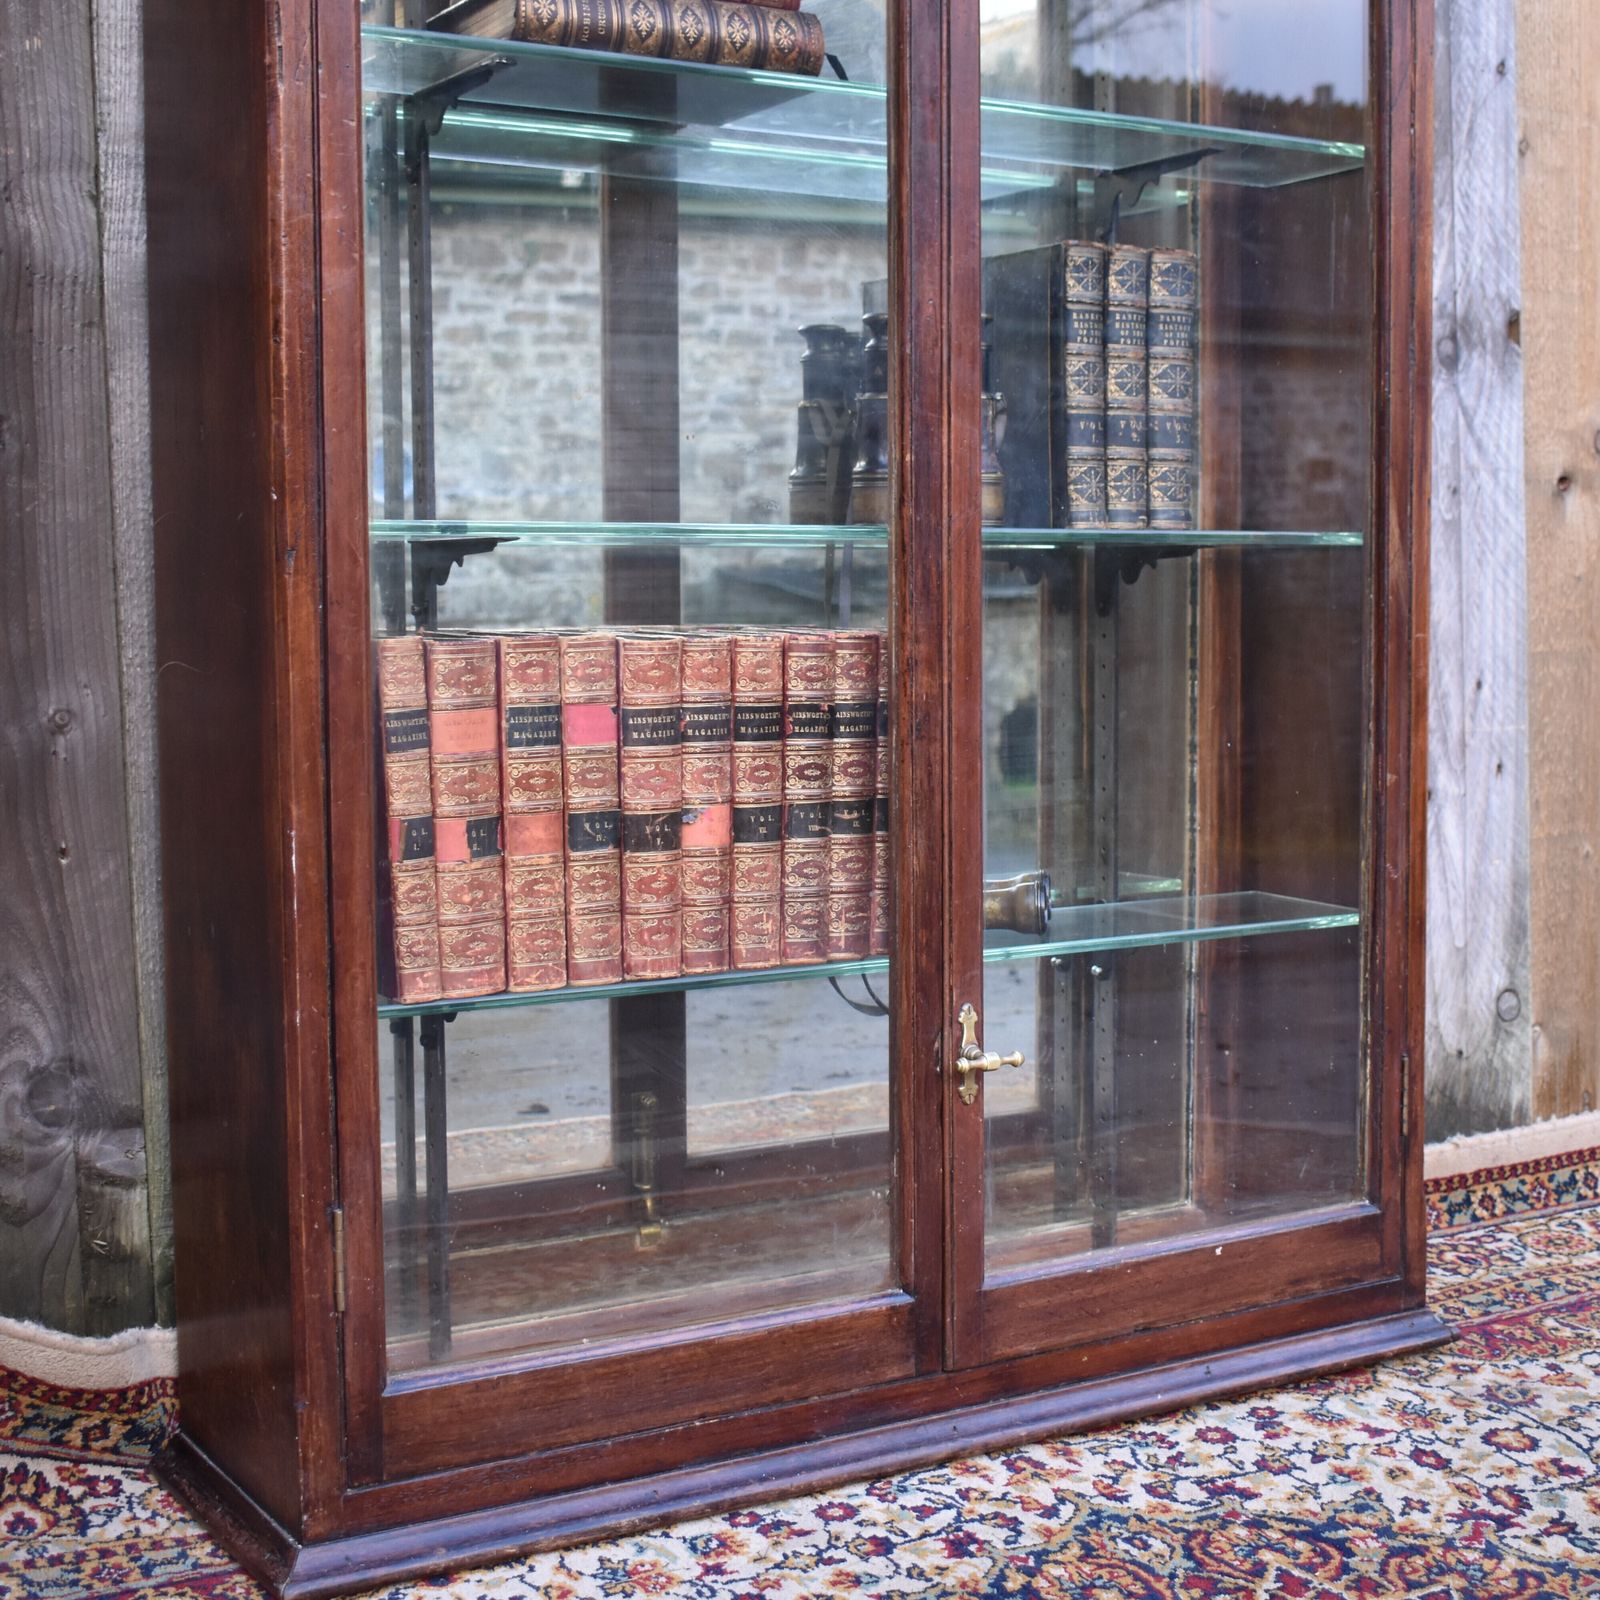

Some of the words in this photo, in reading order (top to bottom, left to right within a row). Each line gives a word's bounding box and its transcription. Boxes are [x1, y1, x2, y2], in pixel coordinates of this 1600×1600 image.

[510, 714, 559, 723] AINSWORTH'S
[628, 715, 676, 724] AINSWORTH'S
[685, 713, 730, 721] AINSWORTH'S
[737, 712, 781, 720] AINSWORTH'S
[386, 717, 427, 728] AINSWORTH'S
[632, 729, 675, 738] MAGAZINE
[687, 728, 727, 736] MAGAZINE
[740, 725, 779, 733] MAGAZINE
[391, 732, 427, 743] MAGAZINE
[513, 730, 557, 739] MAGAZINE
